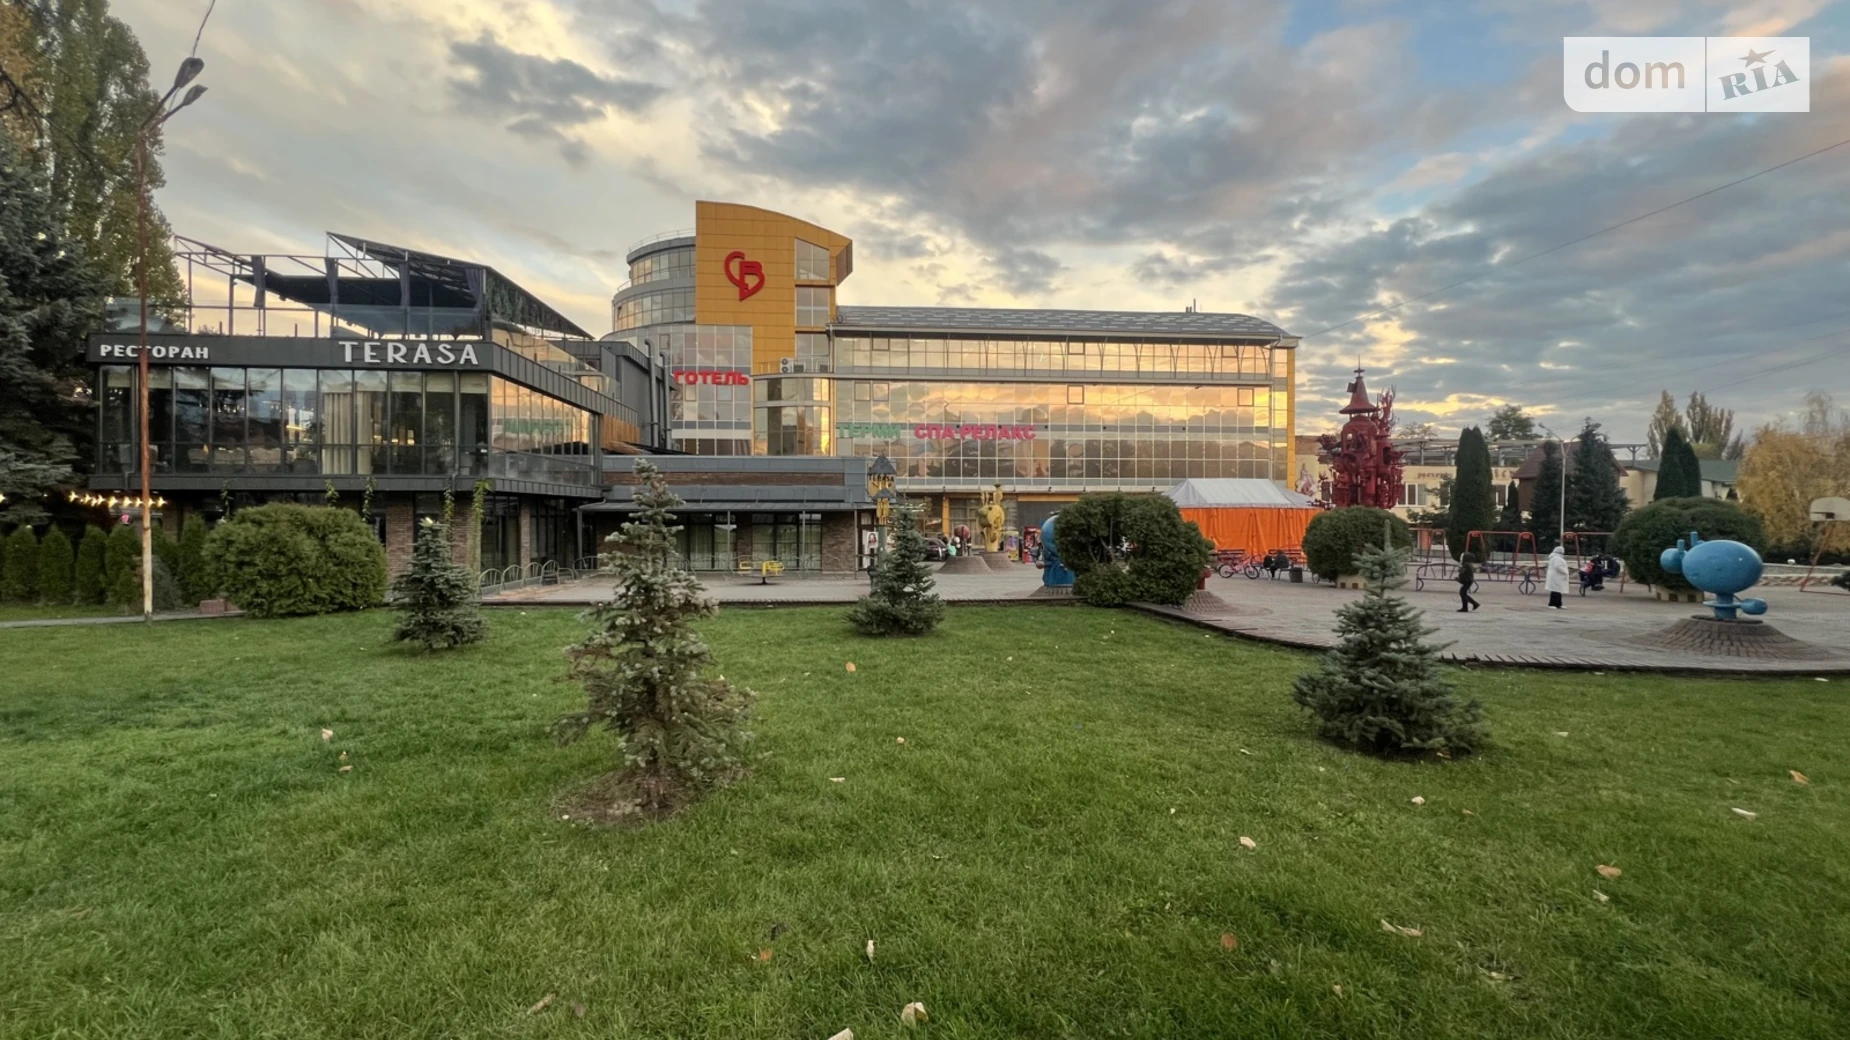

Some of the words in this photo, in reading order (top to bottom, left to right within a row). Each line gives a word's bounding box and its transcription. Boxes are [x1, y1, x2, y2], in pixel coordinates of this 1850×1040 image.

[338, 341, 479, 364] TERASA
[673, 369, 749, 385] ГОТЕЛЬ
[914, 423, 1036, 440] СПА-РЕЛАКС
